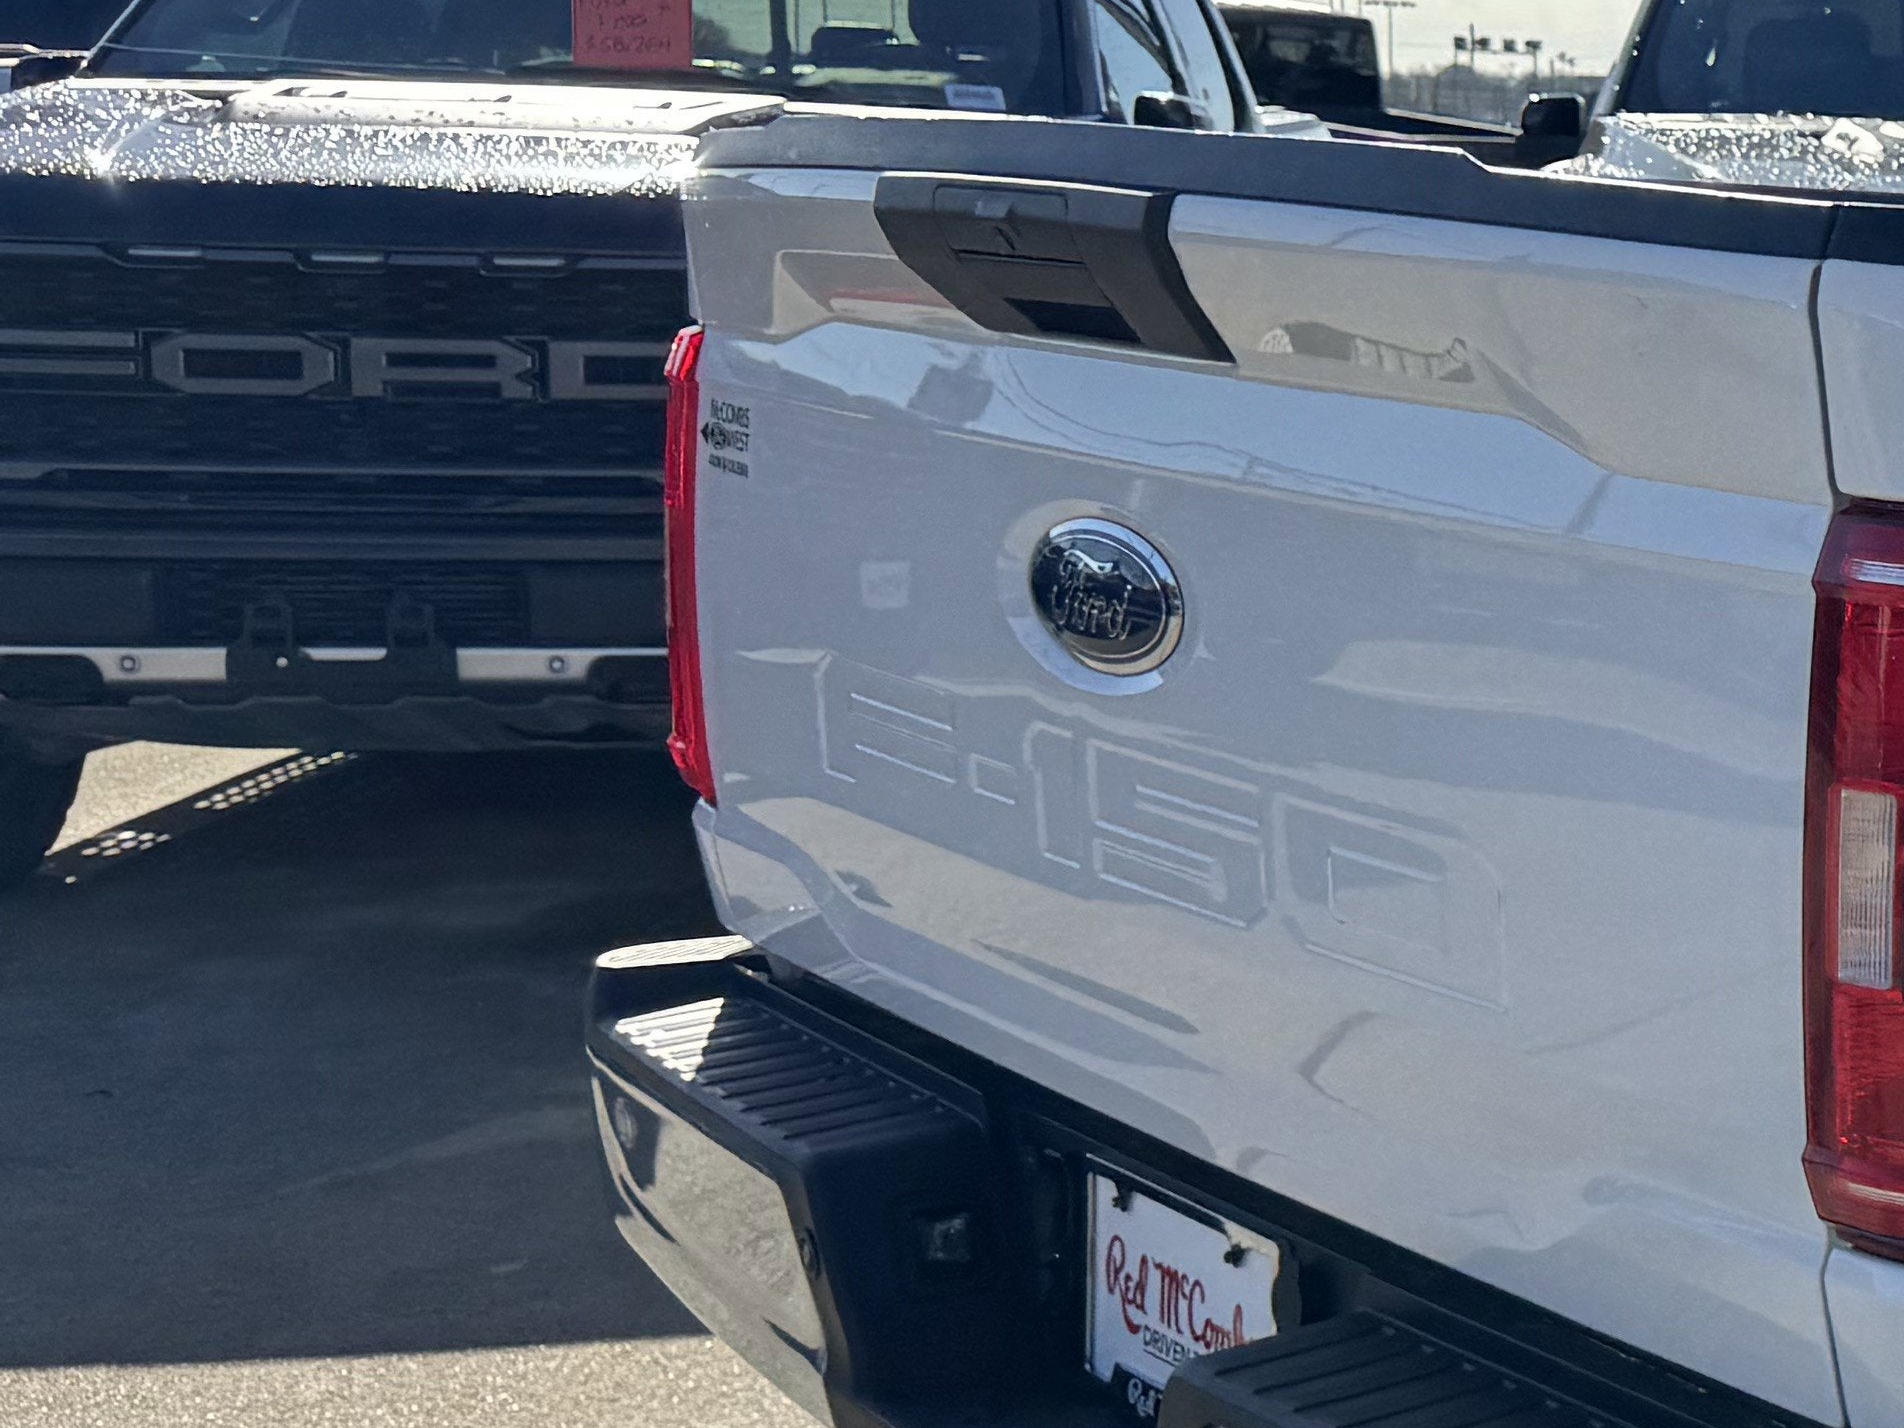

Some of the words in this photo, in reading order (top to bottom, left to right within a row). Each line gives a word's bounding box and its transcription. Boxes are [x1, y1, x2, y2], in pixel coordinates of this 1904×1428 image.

[1049, 548, 1132, 641] Ford
[1105, 1235, 1148, 1335] Red
[1151, 1256, 1245, 1350] McComb
